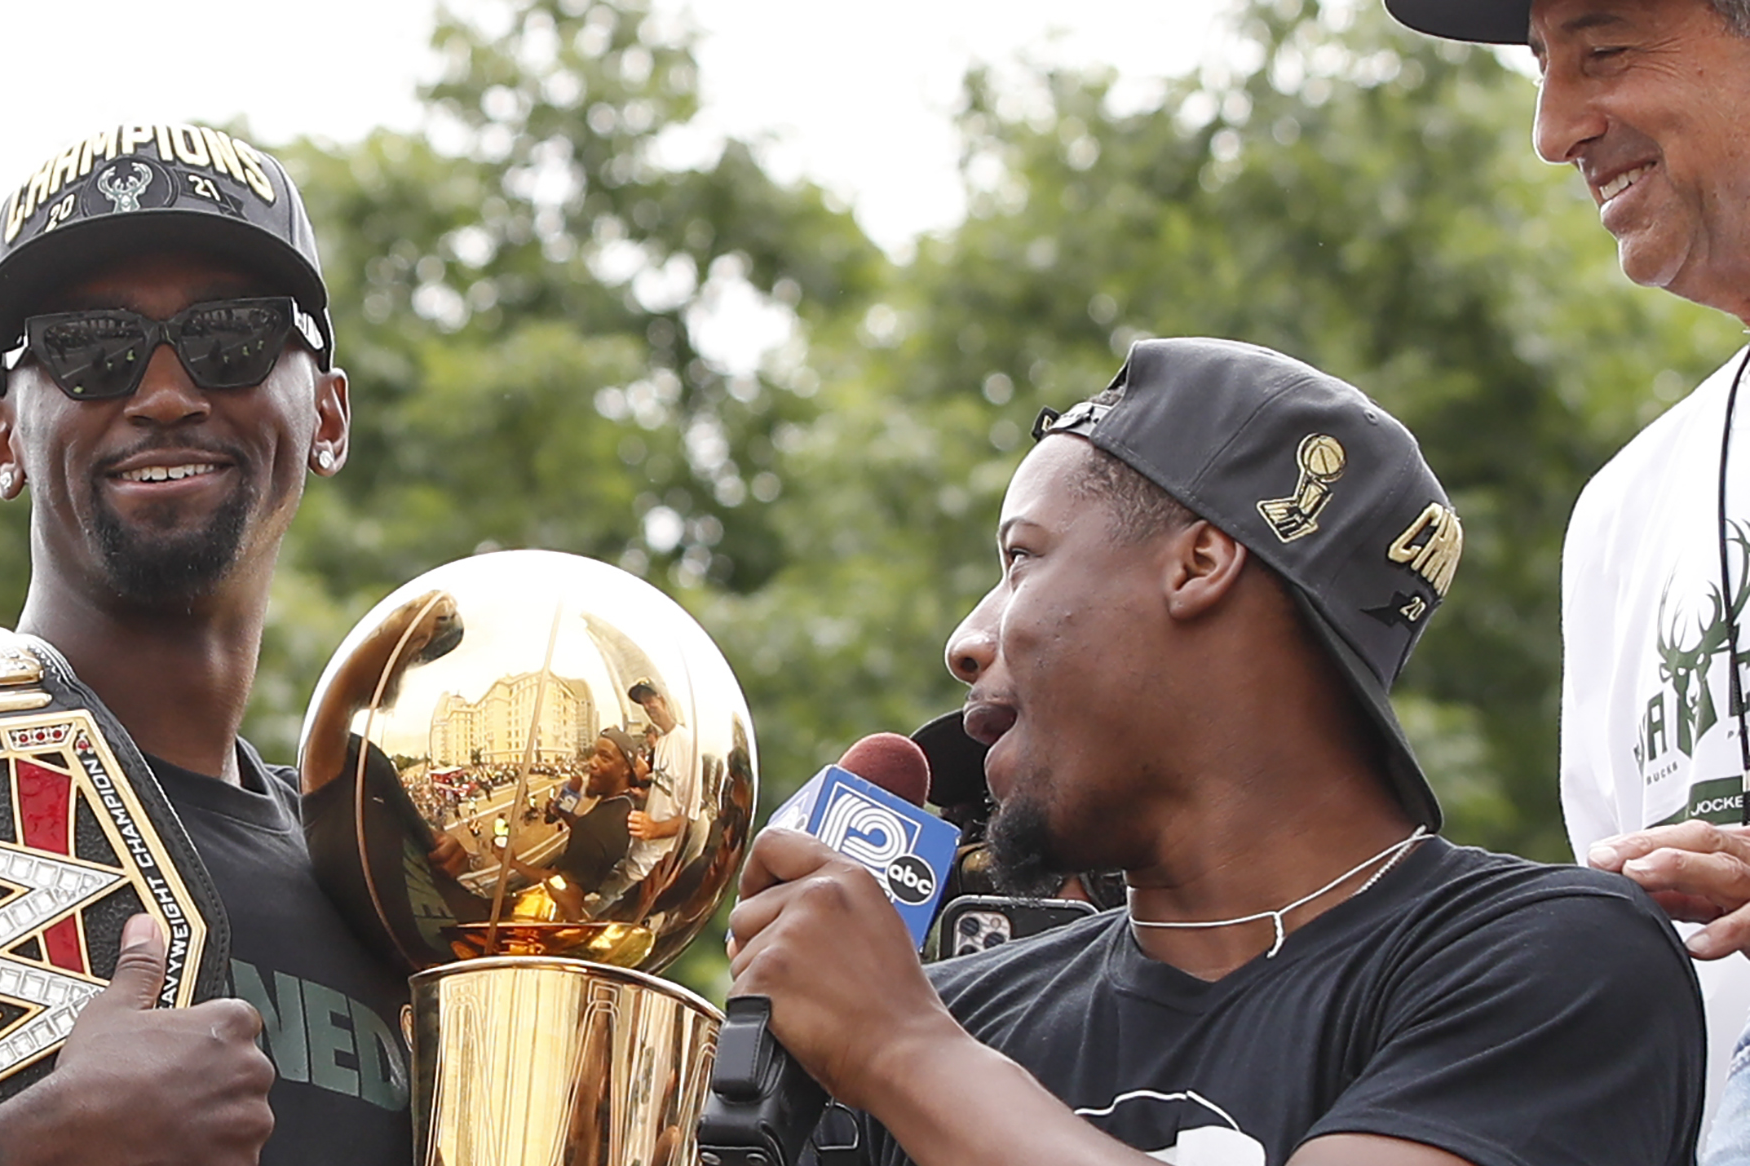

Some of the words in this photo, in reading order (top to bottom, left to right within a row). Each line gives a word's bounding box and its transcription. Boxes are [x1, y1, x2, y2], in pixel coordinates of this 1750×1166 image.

[4, 124, 276, 245] CHAMPIONS
[44, 193, 76, 233] 20
[188, 174, 221, 202] 21
[1399, 596, 1427, 621] 20
[83, 757, 155, 869] CHAMPION
[888, 864, 933, 896] abc
[148, 876, 189, 1010] AVYWEIGHT
[223, 957, 408, 1113] NED
